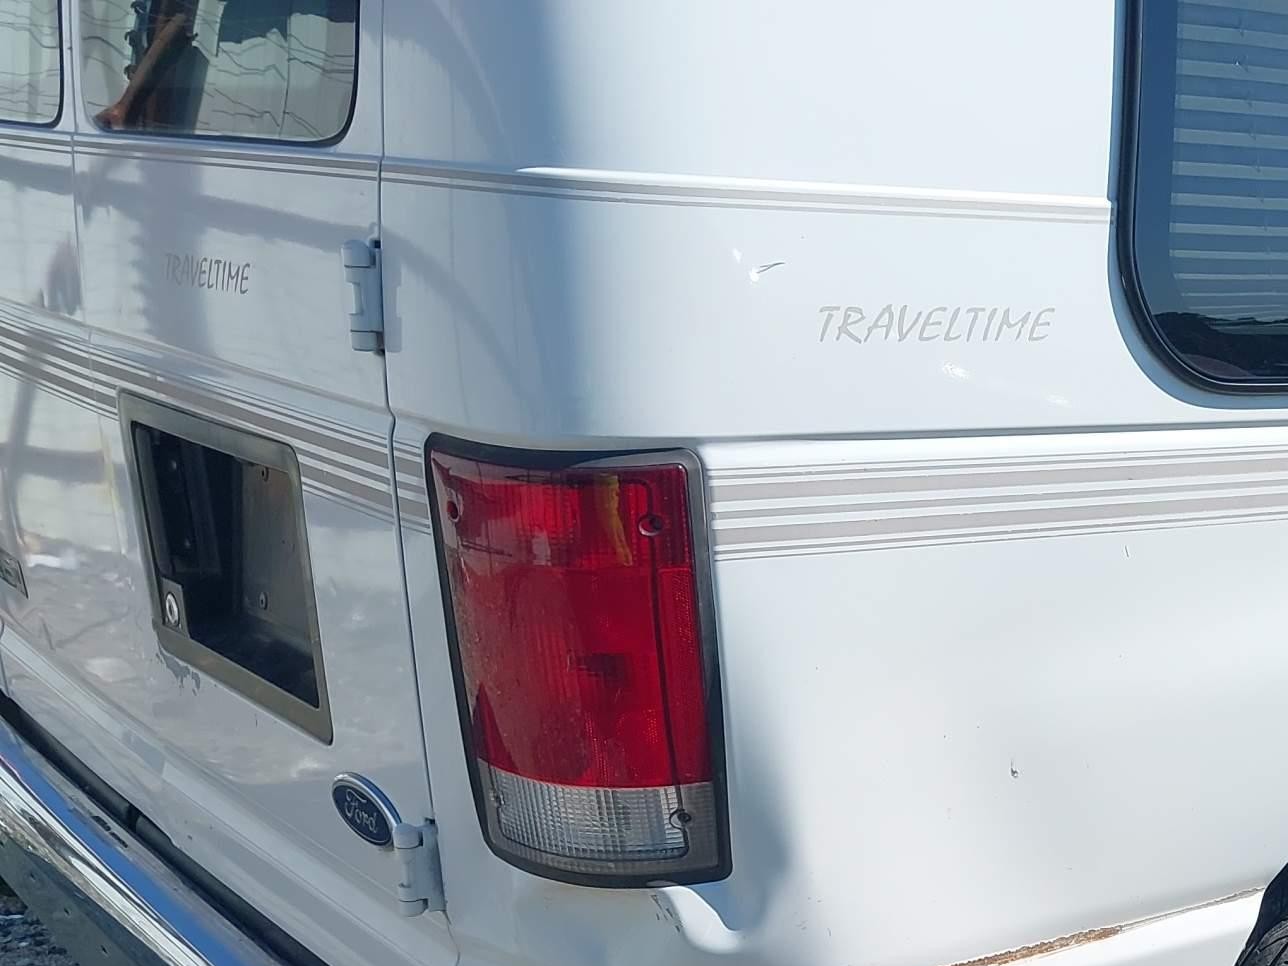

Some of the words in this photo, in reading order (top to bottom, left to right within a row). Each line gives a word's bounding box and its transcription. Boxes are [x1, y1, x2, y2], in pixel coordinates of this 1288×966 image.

[165, 252, 251, 294] TRAVELTIME
[818, 303, 1055, 344] TRAVELTIME
[344, 788, 378, 834] Ford
